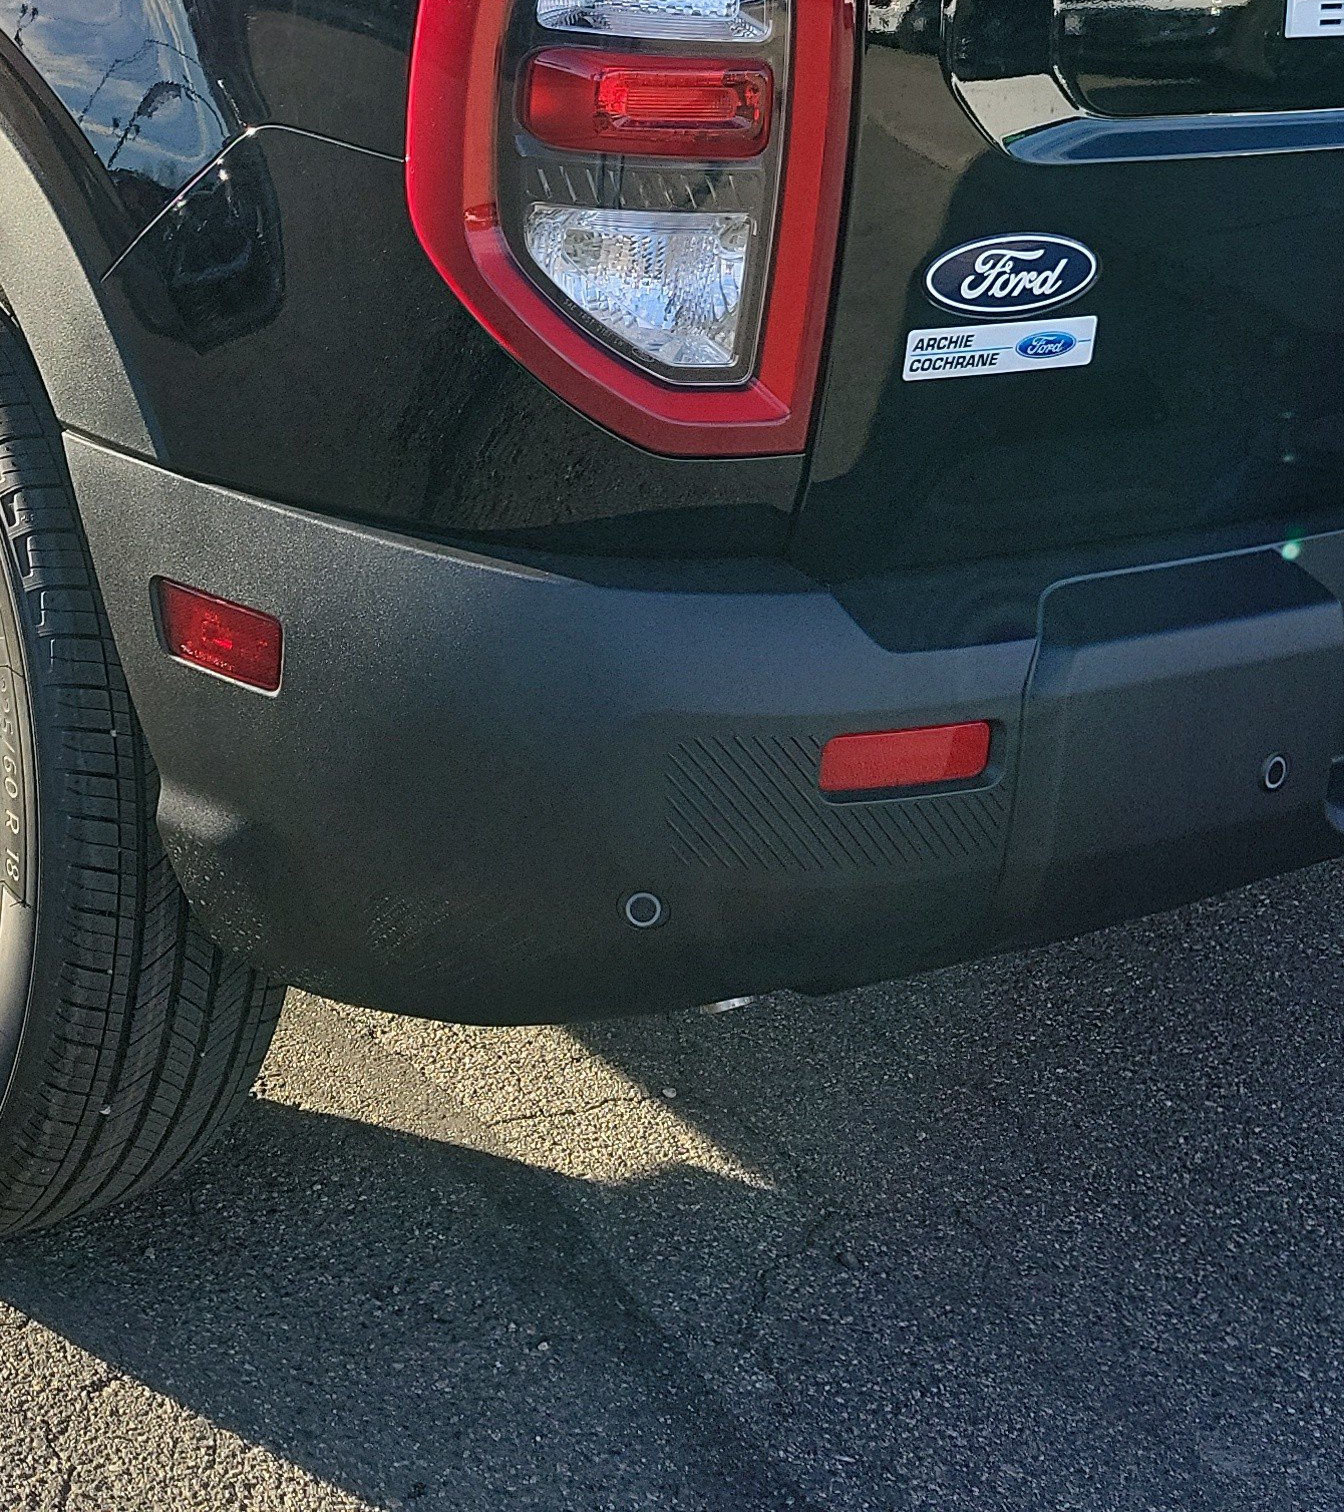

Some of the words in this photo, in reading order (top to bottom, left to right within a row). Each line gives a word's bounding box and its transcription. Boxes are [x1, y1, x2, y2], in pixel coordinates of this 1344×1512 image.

[960, 249, 1069, 300] Ford
[913, 335, 975, 352] ARCHIE
[1027, 336, 1066, 355] Ford
[909, 353, 1000, 373] COCHRANE
[6, 849, 20, 882] 18
